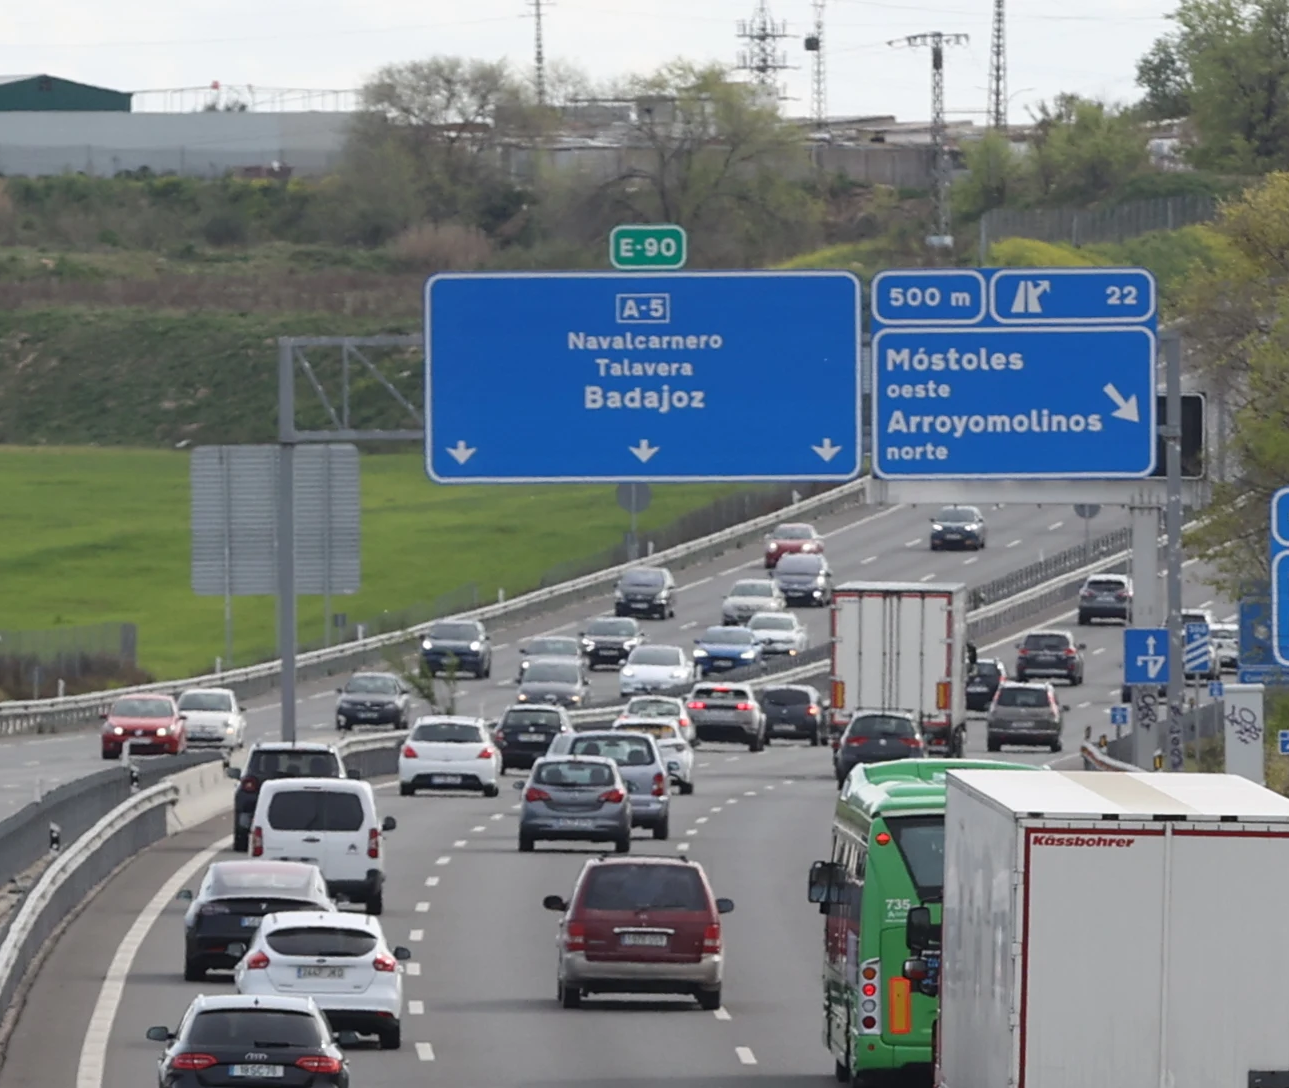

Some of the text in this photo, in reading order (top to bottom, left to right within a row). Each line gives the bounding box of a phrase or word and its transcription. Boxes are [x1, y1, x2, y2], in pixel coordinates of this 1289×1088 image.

[620, 237, 677, 257] E-90
[889, 287, 971, 307] 500 m
[1105, 285, 1138, 305] 22
[622, 299, 664, 318] A-5
[567, 332, 723, 350] Navalcarnero
[595, 358, 693, 377] Talavera
[886, 347, 1024, 371] Móstoles
[584, 384, 706, 413] Badajoz
[886, 380, 951, 398] oeste
[886, 409, 1103, 438] Arroyomolinos
[886, 443, 949, 461] norte
[1032, 835, 1135, 847] Kässbohrer
[885, 899, 910, 910] 735
